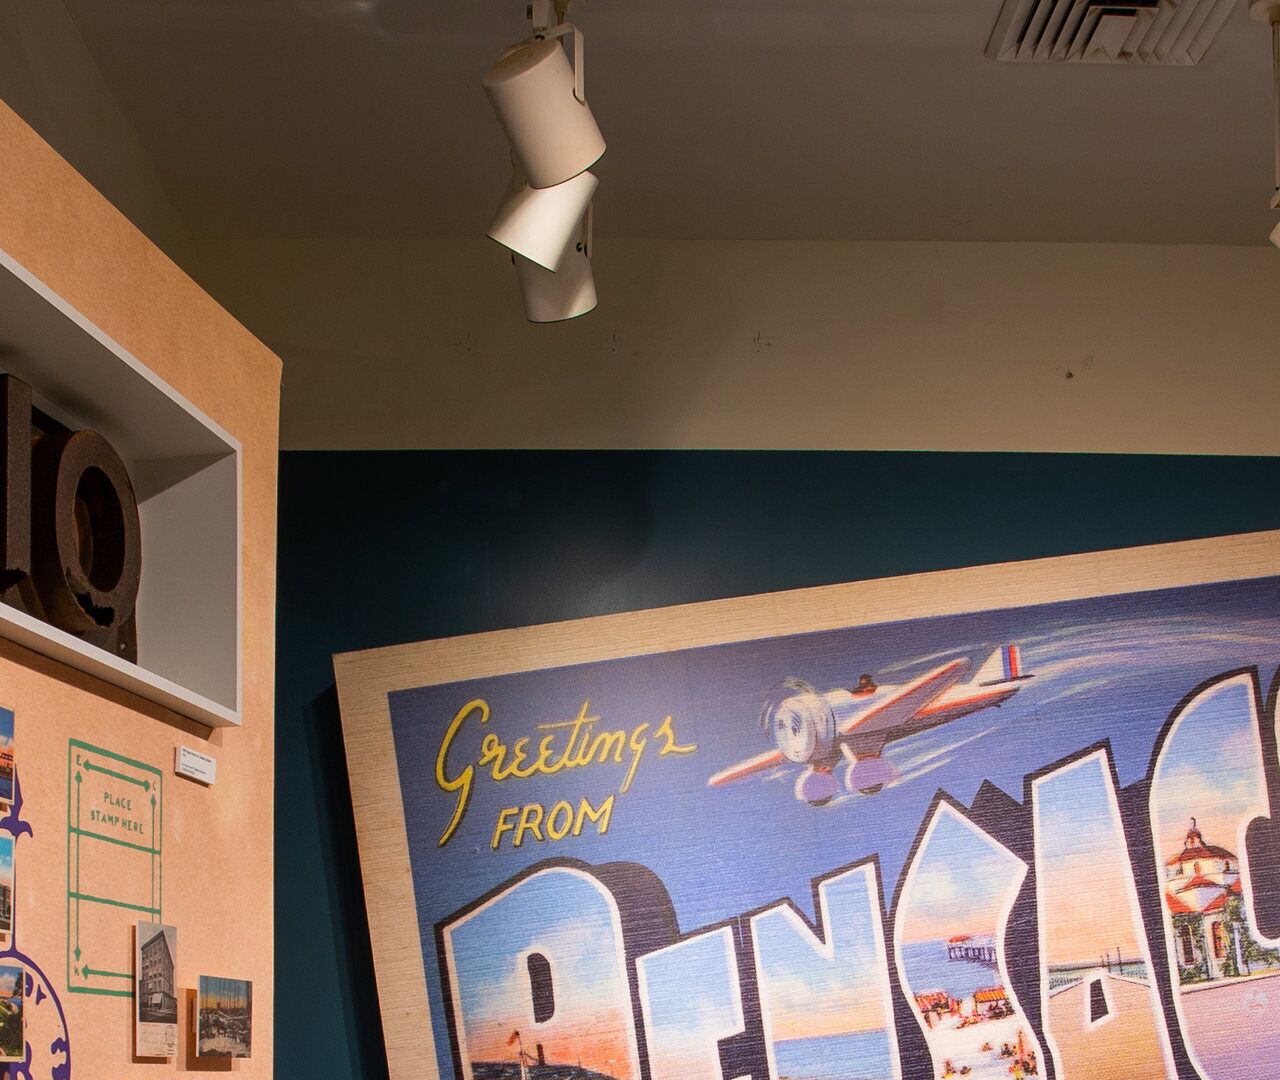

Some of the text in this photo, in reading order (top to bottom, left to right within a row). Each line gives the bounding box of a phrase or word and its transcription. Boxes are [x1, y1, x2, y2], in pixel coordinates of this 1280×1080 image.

[434, 698, 698, 849] Greetings
[103, 791, 132, 811] PLACE
[491, 793, 615, 850] FROM
[90, 809, 144, 835] STAMP HERE
